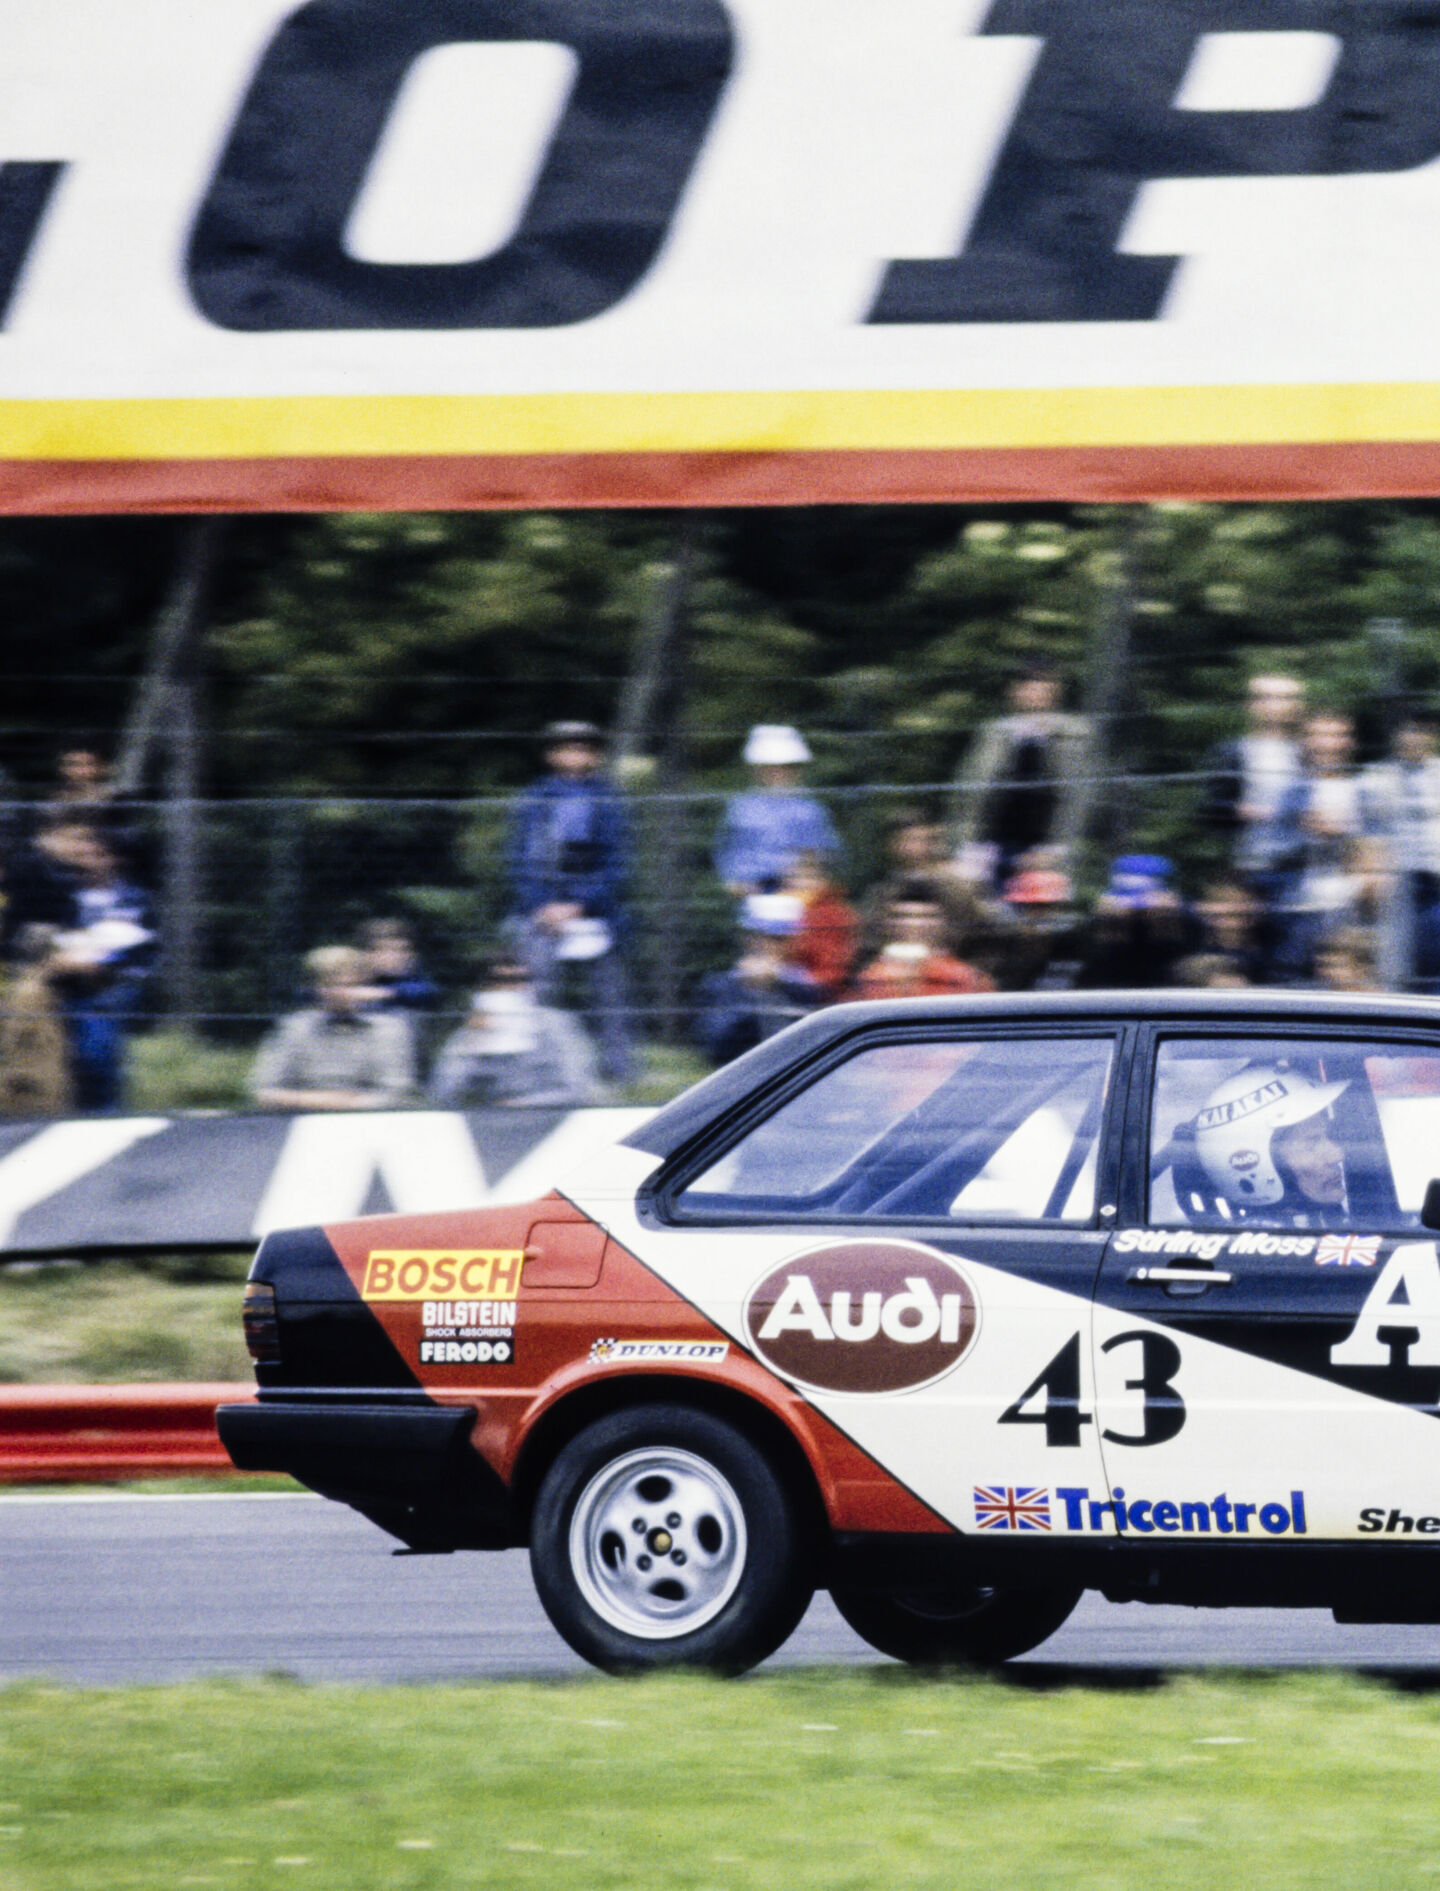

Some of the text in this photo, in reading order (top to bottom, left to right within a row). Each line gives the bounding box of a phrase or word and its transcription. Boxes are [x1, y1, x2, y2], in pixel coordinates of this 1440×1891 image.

[1113, 1230, 1317, 1260] Stirling Moss
[366, 1257, 522, 1295] BOSCH
[422, 1301, 517, 1326] BILSTEIN
[757, 1275, 961, 1344] Audi
[425, 1327, 512, 1337] SHOCK ABSORBERS
[421, 1341, 511, 1362] FERODO
[618, 1344, 725, 1358] DUNLOP
[997, 1329, 1188, 1448] 43
[1055, 1486, 1308, 1534] Tricentrol
